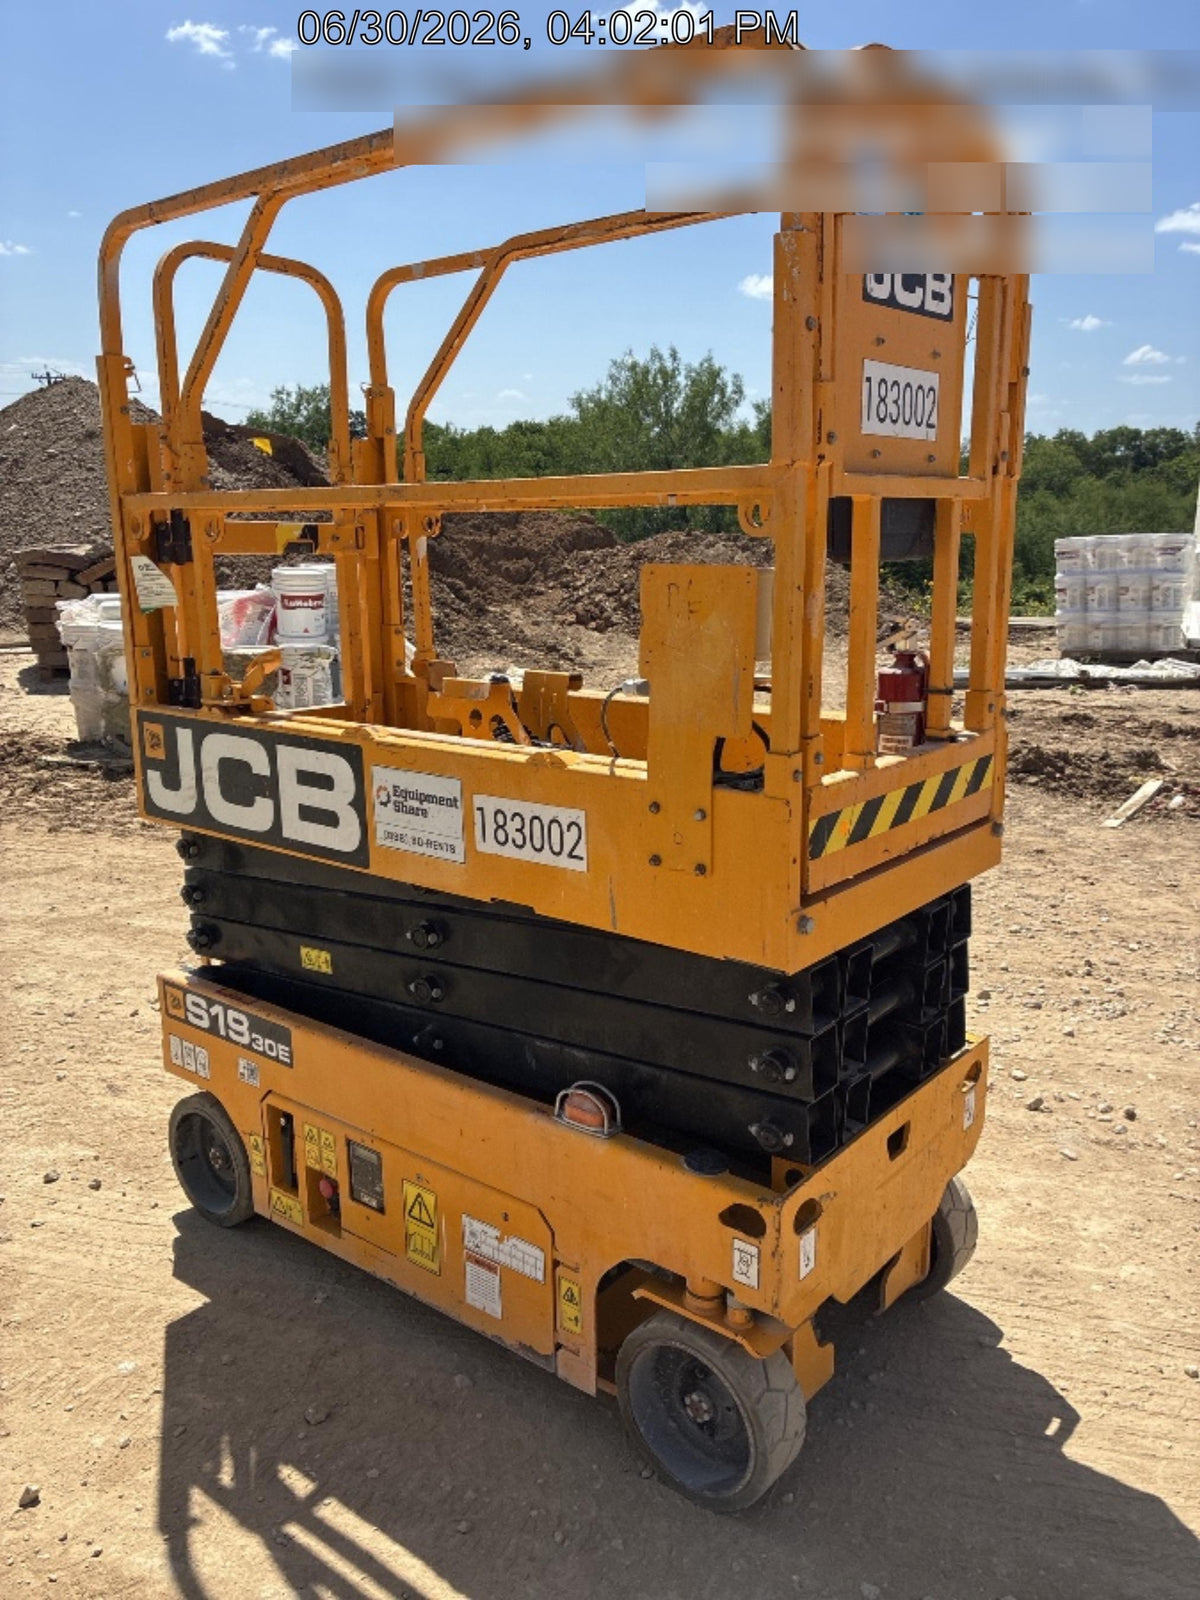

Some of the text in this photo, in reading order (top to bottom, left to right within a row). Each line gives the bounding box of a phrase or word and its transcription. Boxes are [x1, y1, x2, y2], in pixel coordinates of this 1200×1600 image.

[865, 376, 936, 429] 183002
[146, 726, 361, 853] JCB
[392, 784, 459, 810] Equipment
[393, 800, 428, 818] Share
[476, 806, 585, 862] 183002
